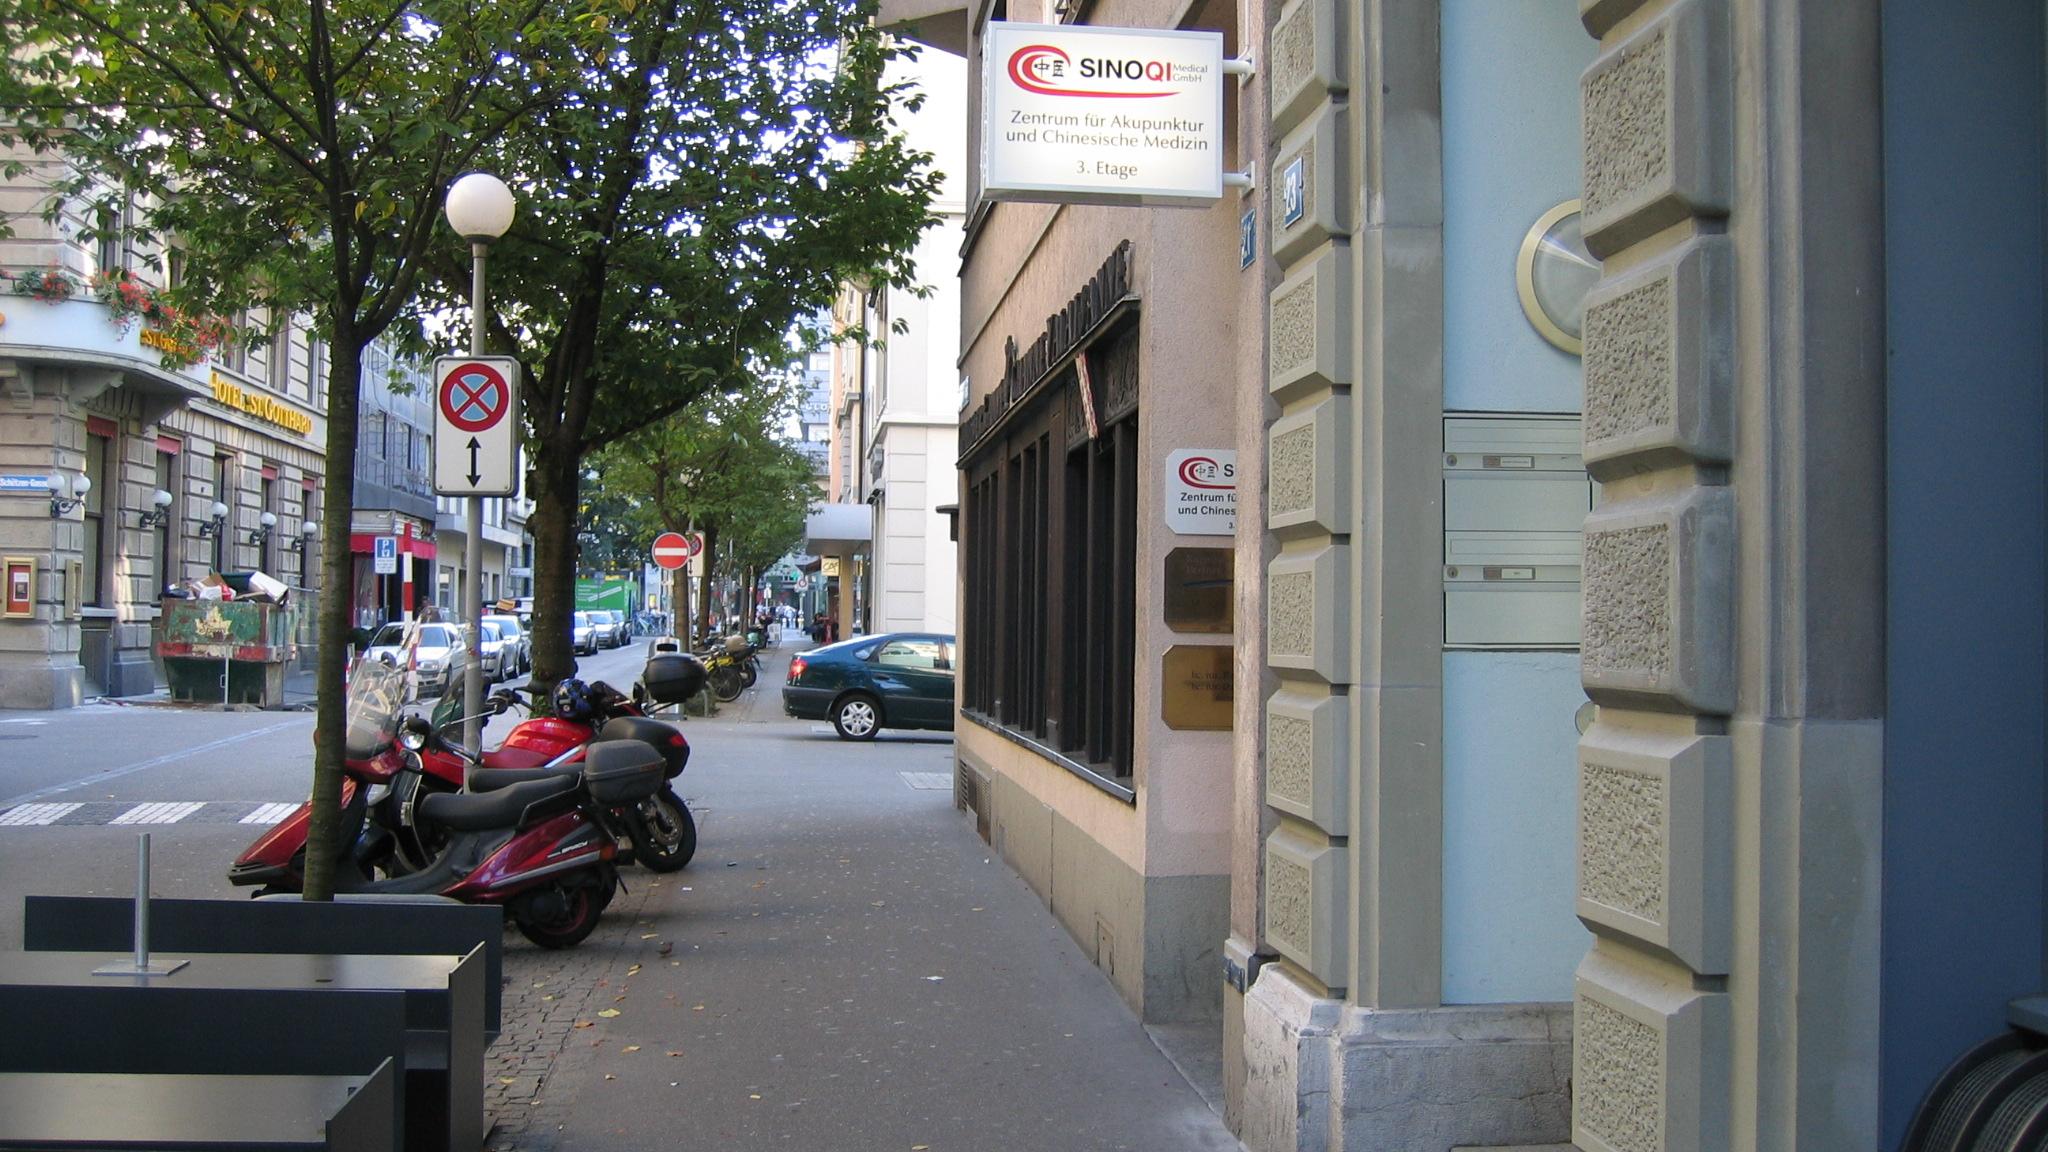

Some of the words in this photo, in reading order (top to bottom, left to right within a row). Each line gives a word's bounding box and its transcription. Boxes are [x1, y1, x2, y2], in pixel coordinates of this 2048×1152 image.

[1080, 58, 1171, 82] SINOQI
[1173, 64, 1208, 73] Medical
[1172, 73, 1202, 82] GmbH
[1010, 109, 1079, 126] Zentrum
[1085, 113, 1106, 128] für
[1110, 115, 1204, 134] Akupunktur
[1006, 129, 1037, 142] und
[1042, 129, 1138, 148] Chinesische
[1144, 135, 1208, 151] Medizin
[1076, 160, 1091, 174] 3.
[1096, 161, 1138, 180] Etage
[210, 370, 247, 412] HOTEL
[264, 395, 313, 436] GOTTHARD
[1180, 492, 1225, 502] Zentrum
[1178, 506, 1198, 515] und
